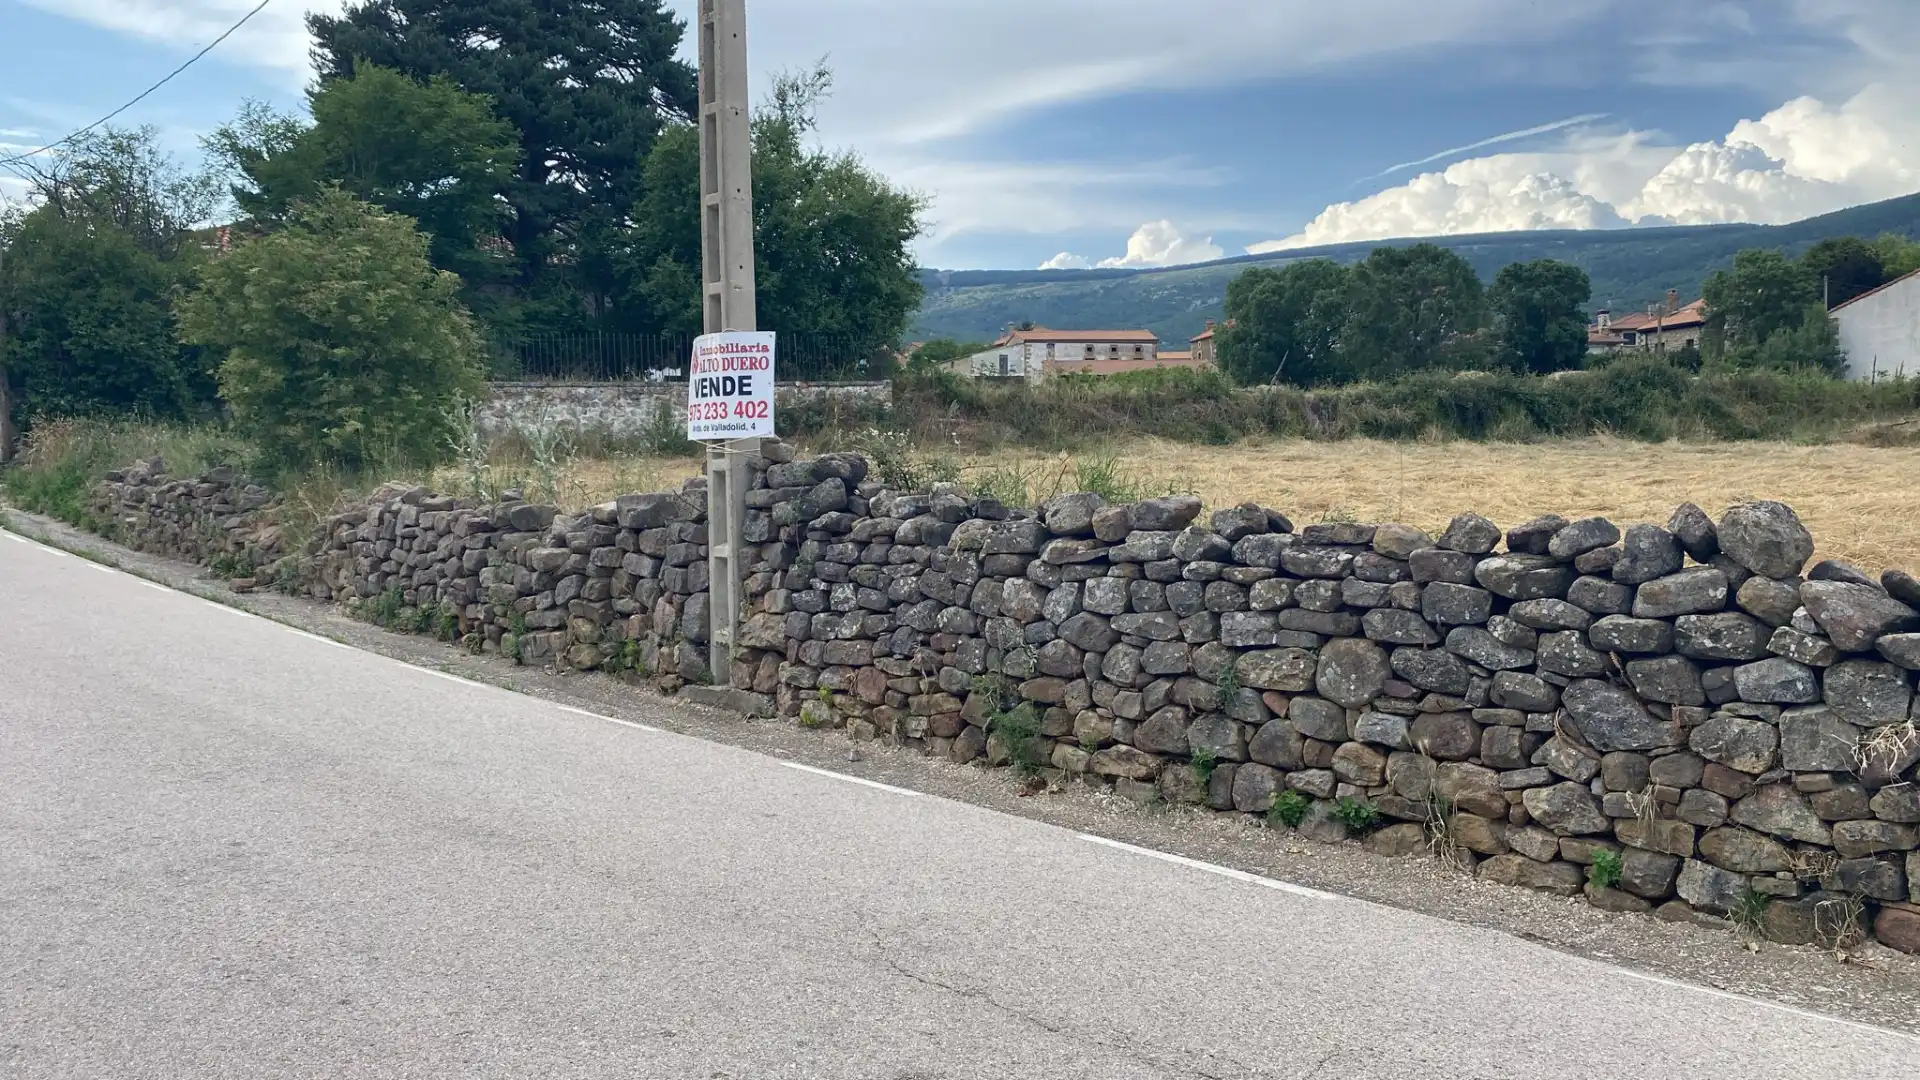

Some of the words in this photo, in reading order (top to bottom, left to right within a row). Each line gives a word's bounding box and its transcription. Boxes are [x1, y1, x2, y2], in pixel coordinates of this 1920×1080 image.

[699, 358, 720, 374] ALTO
[722, 356, 770, 371] DUERO
[694, 376, 752, 398] VENDE
[690, 404, 702, 422] 975
[704, 402, 728, 420] 233
[734, 400, 768, 418] 402
[711, 422, 748, 432] Valladolid,
[751, 422, 756, 430] 4
